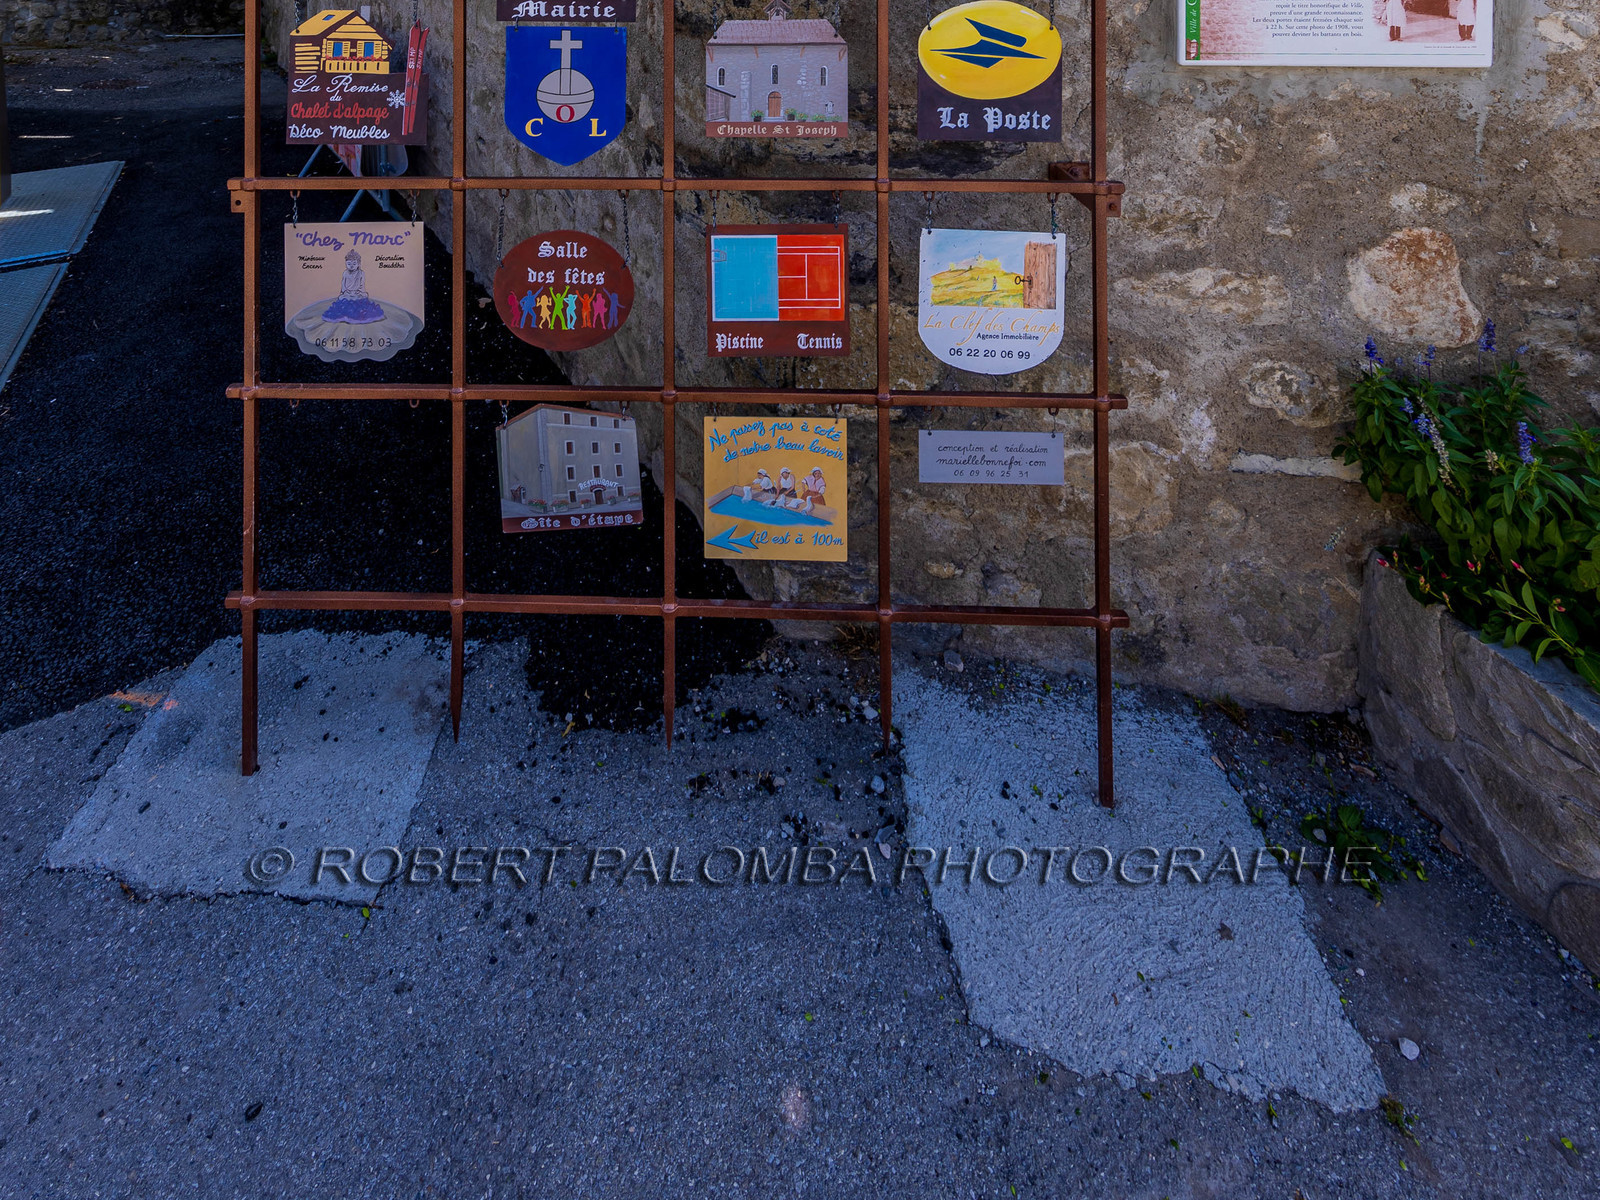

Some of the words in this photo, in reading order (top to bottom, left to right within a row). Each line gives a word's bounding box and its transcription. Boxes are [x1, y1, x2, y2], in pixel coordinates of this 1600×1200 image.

[512, 0, 616, 18] Mairie
[292, 75, 320, 93] La
[326, 74, 388, 93] Remise
[330, 90, 343, 101] du
[291, 103, 331, 119] Chalet
[333, 102, 389, 125] d'alpage
[937, 107, 969, 129] La
[983, 107, 1051, 133] Poste
[289, 124, 323, 138] Déco
[330, 125, 390, 139] Meubles
[717, 125, 767, 136] Chapelle
[772, 125, 790, 135] St
[796, 125, 837, 136] Joseph
[538, 241, 588, 258] Salle
[527, 267, 555, 283] des
[564, 268, 605, 285] fêtes
[924, 314, 945, 329] La
[950, 308, 993, 346] Clef
[984, 311, 1004, 331] des
[1010, 310, 1060, 346] Champs
[715, 333, 763, 352] Piscine
[797, 333, 842, 349] Tennis
[1001, 332, 1039, 340] Immobilière
[709, 428, 729, 452] Ne
[729, 421, 765, 445] passez
[769, 421, 793, 437] pas
[800, 422, 810, 432] à
[723, 448, 738, 462] de
[740, 441, 771, 456] notre
[775, 436, 804, 450] beau
[808, 438, 844, 460] lavoir
[937, 444, 984, 455] conception
[990, 444, 998, 453] et
[1004, 443, 1048, 453] réalisation
[578, 479, 619, 491] RESTAURANT
[521, 517, 560, 529] Gîte
[570, 514, 634, 527] d'étape
[755, 530, 768, 544] il
[771, 533, 790, 544] est
[794, 533, 804, 544] à
